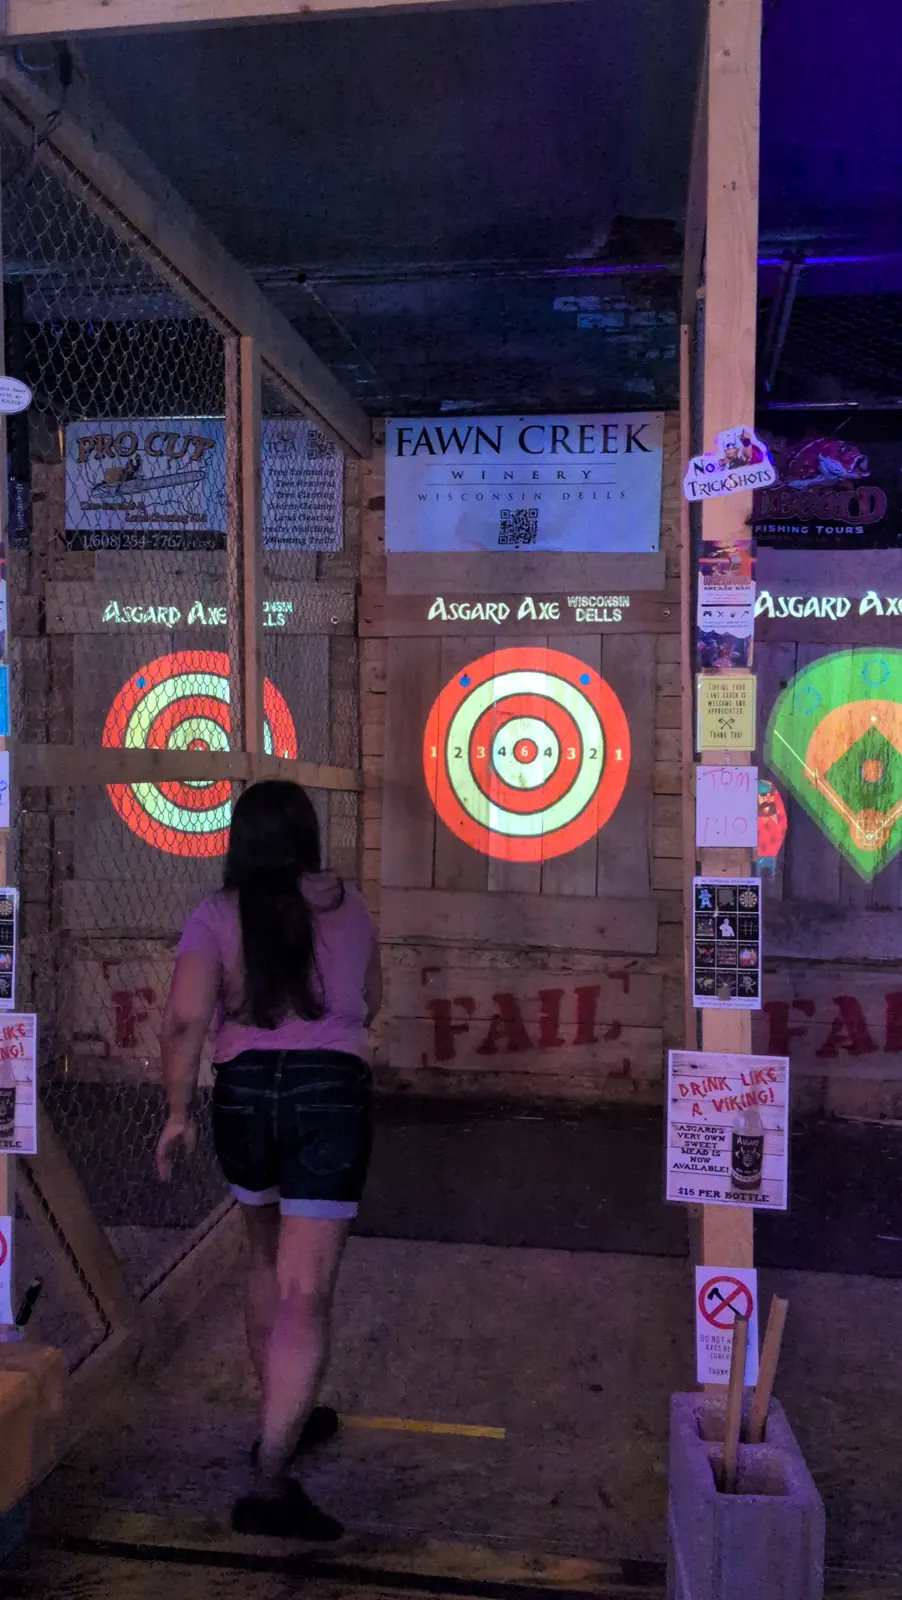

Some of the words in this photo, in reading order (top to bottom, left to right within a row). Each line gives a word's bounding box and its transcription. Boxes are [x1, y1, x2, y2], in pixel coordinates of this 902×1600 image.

[76, 431, 139, 463] PRO
[144, 432, 216, 461] CUT
[395, 425, 504, 457] FAWN
[518, 423, 653, 454] CREEK
[451, 470, 592, 480] WINERY
[693, 459, 715, 477] NO
[418, 492, 542, 501] WISCONSIN
[562, 490, 627, 500] DELLS
[755, 525, 809, 533] FISHING
[816, 526, 864, 534] TOURS
[428, 597, 511, 624] ASGARD
[517, 597, 561, 621] AXE
[567, 595, 630, 607] WISCONSIN
[754, 590, 851, 620] ASGARD
[859, 590, 902, 615] AX
[103, 600, 181, 628] ASGARD
[187, 600, 227, 625] AXE
[575, 608, 622, 622] DELLS
[431, 746, 438, 758] 1
[454, 747, 462, 758] 2
[477, 747, 485, 758] 3
[498, 746, 506, 757] 4
[521, 746, 529, 757] 6
[544, 747, 552, 758] 4
[567, 748, 576, 760] 3
[589, 749, 598, 759] 2
[615, 749, 624, 760] 1
[703, 768, 750, 793] TOM
[426, 985, 622, 1060] FAIL
[0, 1023, 26, 1043] IKE
[678, 1076, 732, 1098] DRINK
[740, 1067, 777, 1086] LIKE
[692, 1102, 703, 1117] A
[712, 1087, 775, 1113] VIKING!
[675, 1125, 725, 1134] ASGARD'S
[677, 1132, 700, 1141] VERY
[681, 1148, 709, 1156] MEAD
[712, 1149, 721, 1157] IS
[684, 1141, 718, 1149] SWEET
[672, 1162, 729, 1174] AVAILABLE!
[690, 1156, 712, 1164] NOW
[678, 1186, 695, 1196] $15
[698, 1189, 721, 1199] PER
[725, 1191, 770, 1203] BOTTLE
